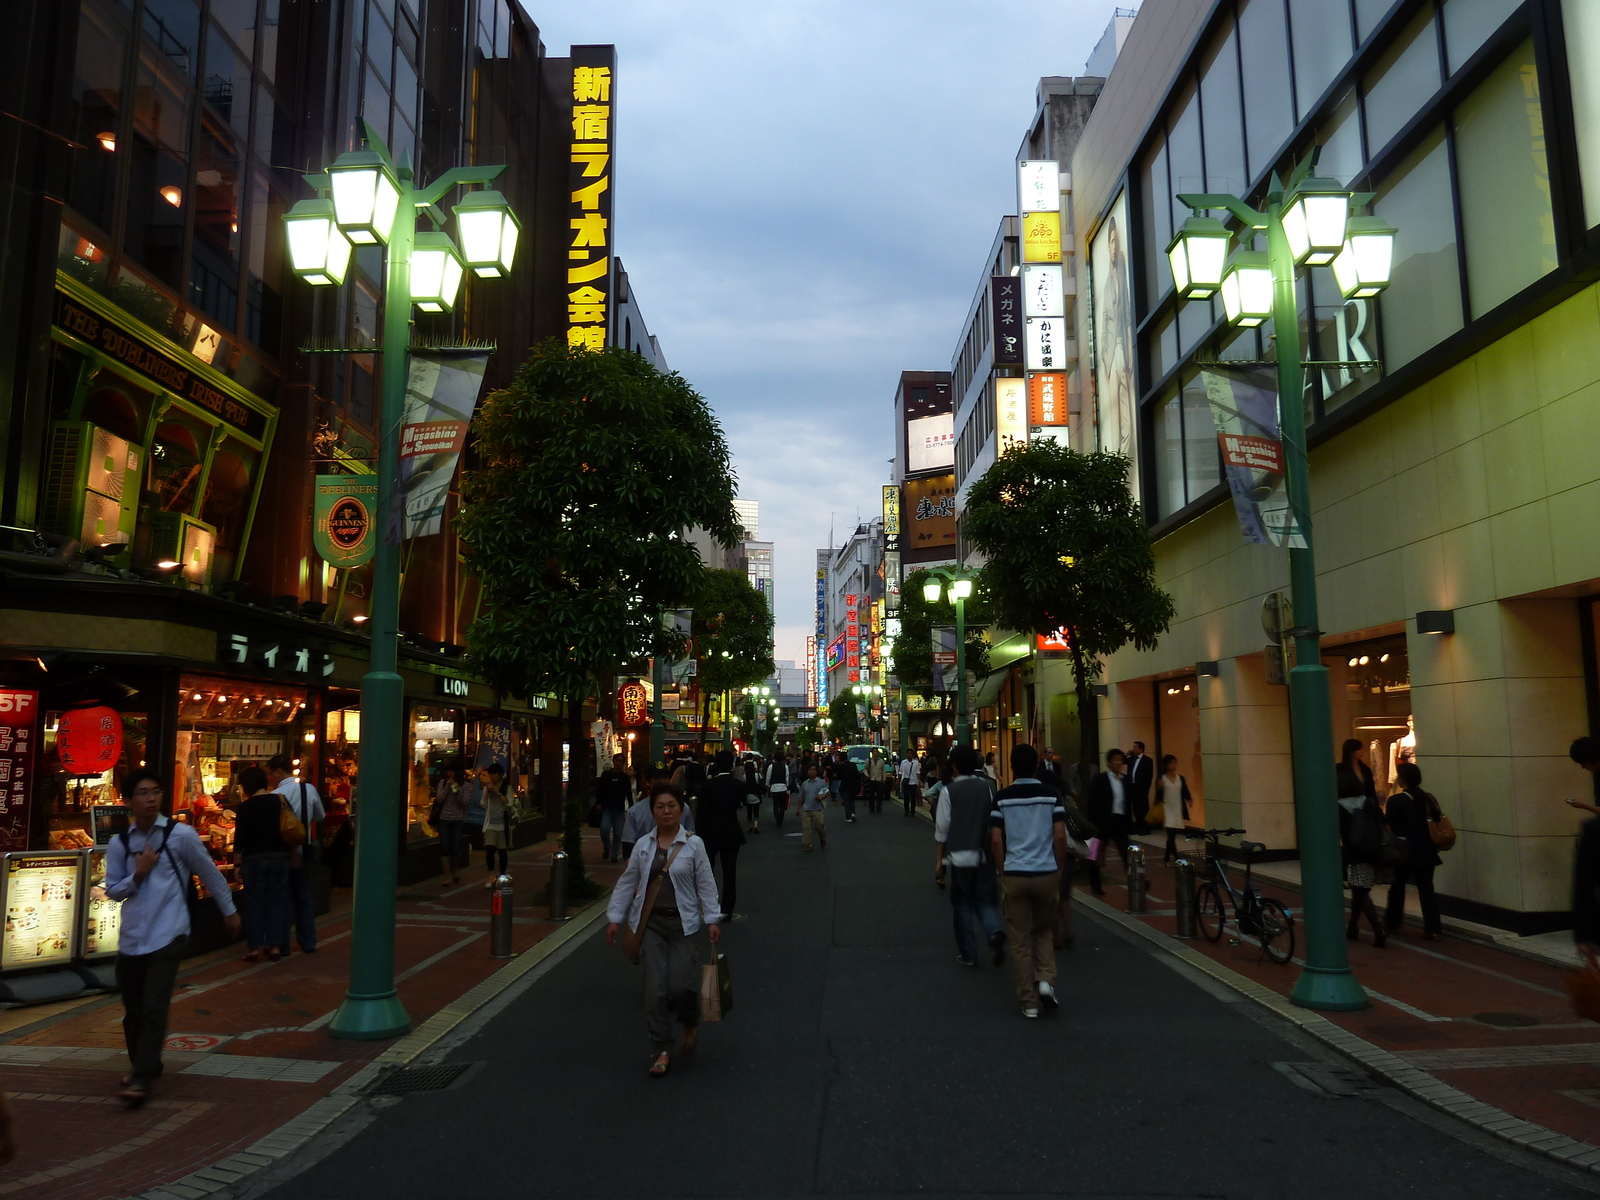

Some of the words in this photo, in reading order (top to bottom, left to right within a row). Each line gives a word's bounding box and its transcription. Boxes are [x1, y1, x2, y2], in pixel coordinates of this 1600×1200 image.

[1001, 285, 1014, 325] メガネ
[63, 304, 100, 340] THE
[102, 327, 188, 391] DUBLINERS
[189, 380, 226, 414] IRISH
[225, 400, 249, 427] PUB
[403, 427, 456, 444] Musashino
[1225, 438, 1276, 458] Musashino
[319, 485, 378, 494] DUBLINERS
[330, 519, 367, 527] GUINNESS
[817, 582, 825, 631] カラオケ
[846, 594, 859, 682] 新宿国際劇場
[231, 633, 335, 677] ライオン
[444, 678, 468, 696] LION
[0, 694, 33, 712] 5F
[533, 696, 547, 709] LION
[93, 899, 105, 910] 5F
